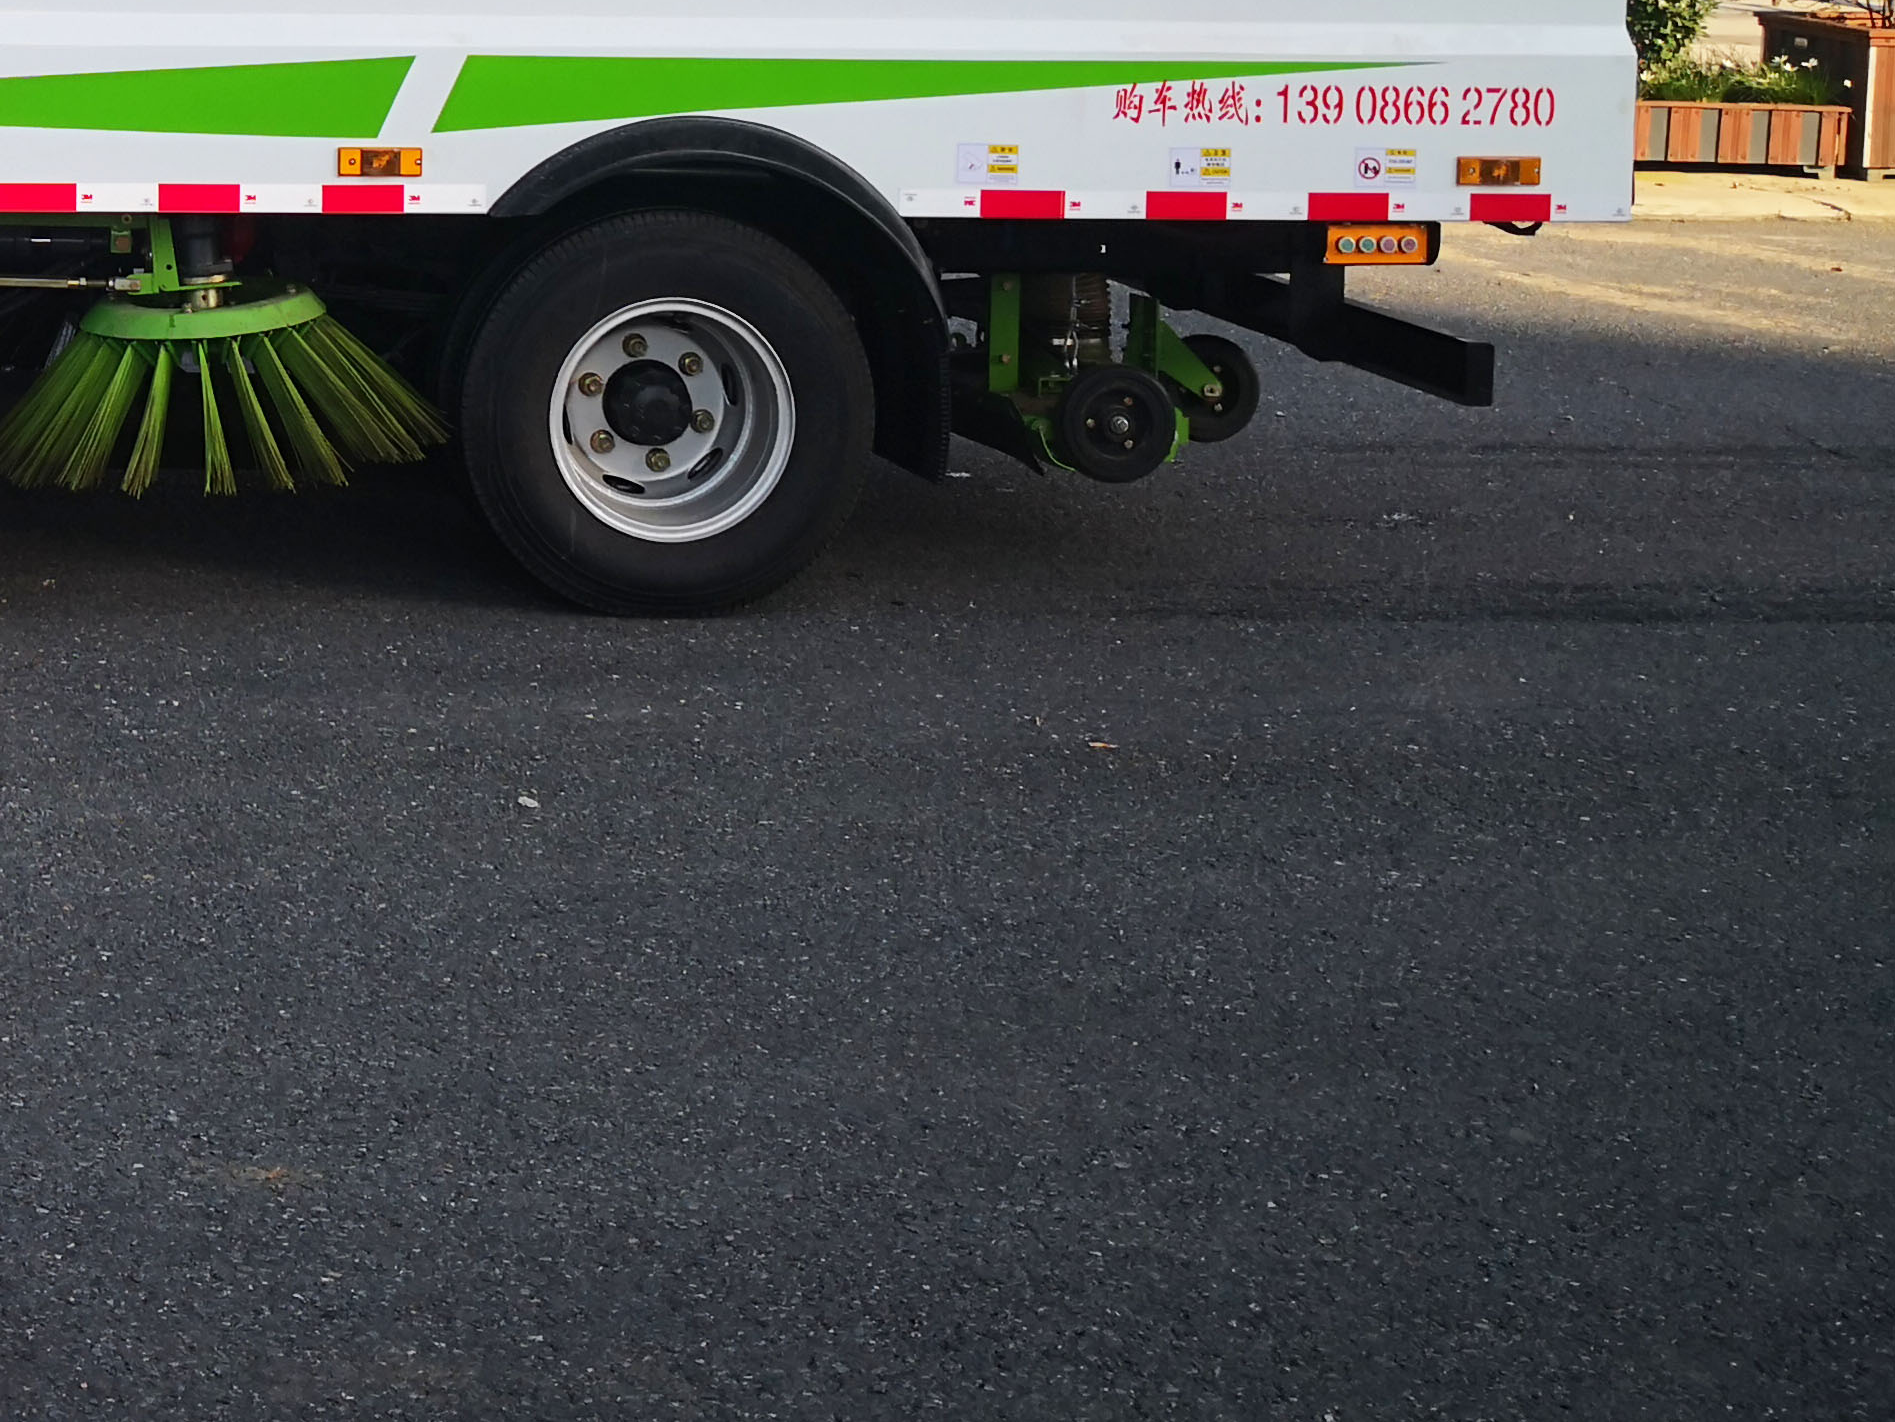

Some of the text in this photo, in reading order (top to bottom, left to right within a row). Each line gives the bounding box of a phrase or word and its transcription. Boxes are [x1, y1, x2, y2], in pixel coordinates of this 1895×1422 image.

[1113, 79, 1555, 127] 购车热线: 139 0866 2780
